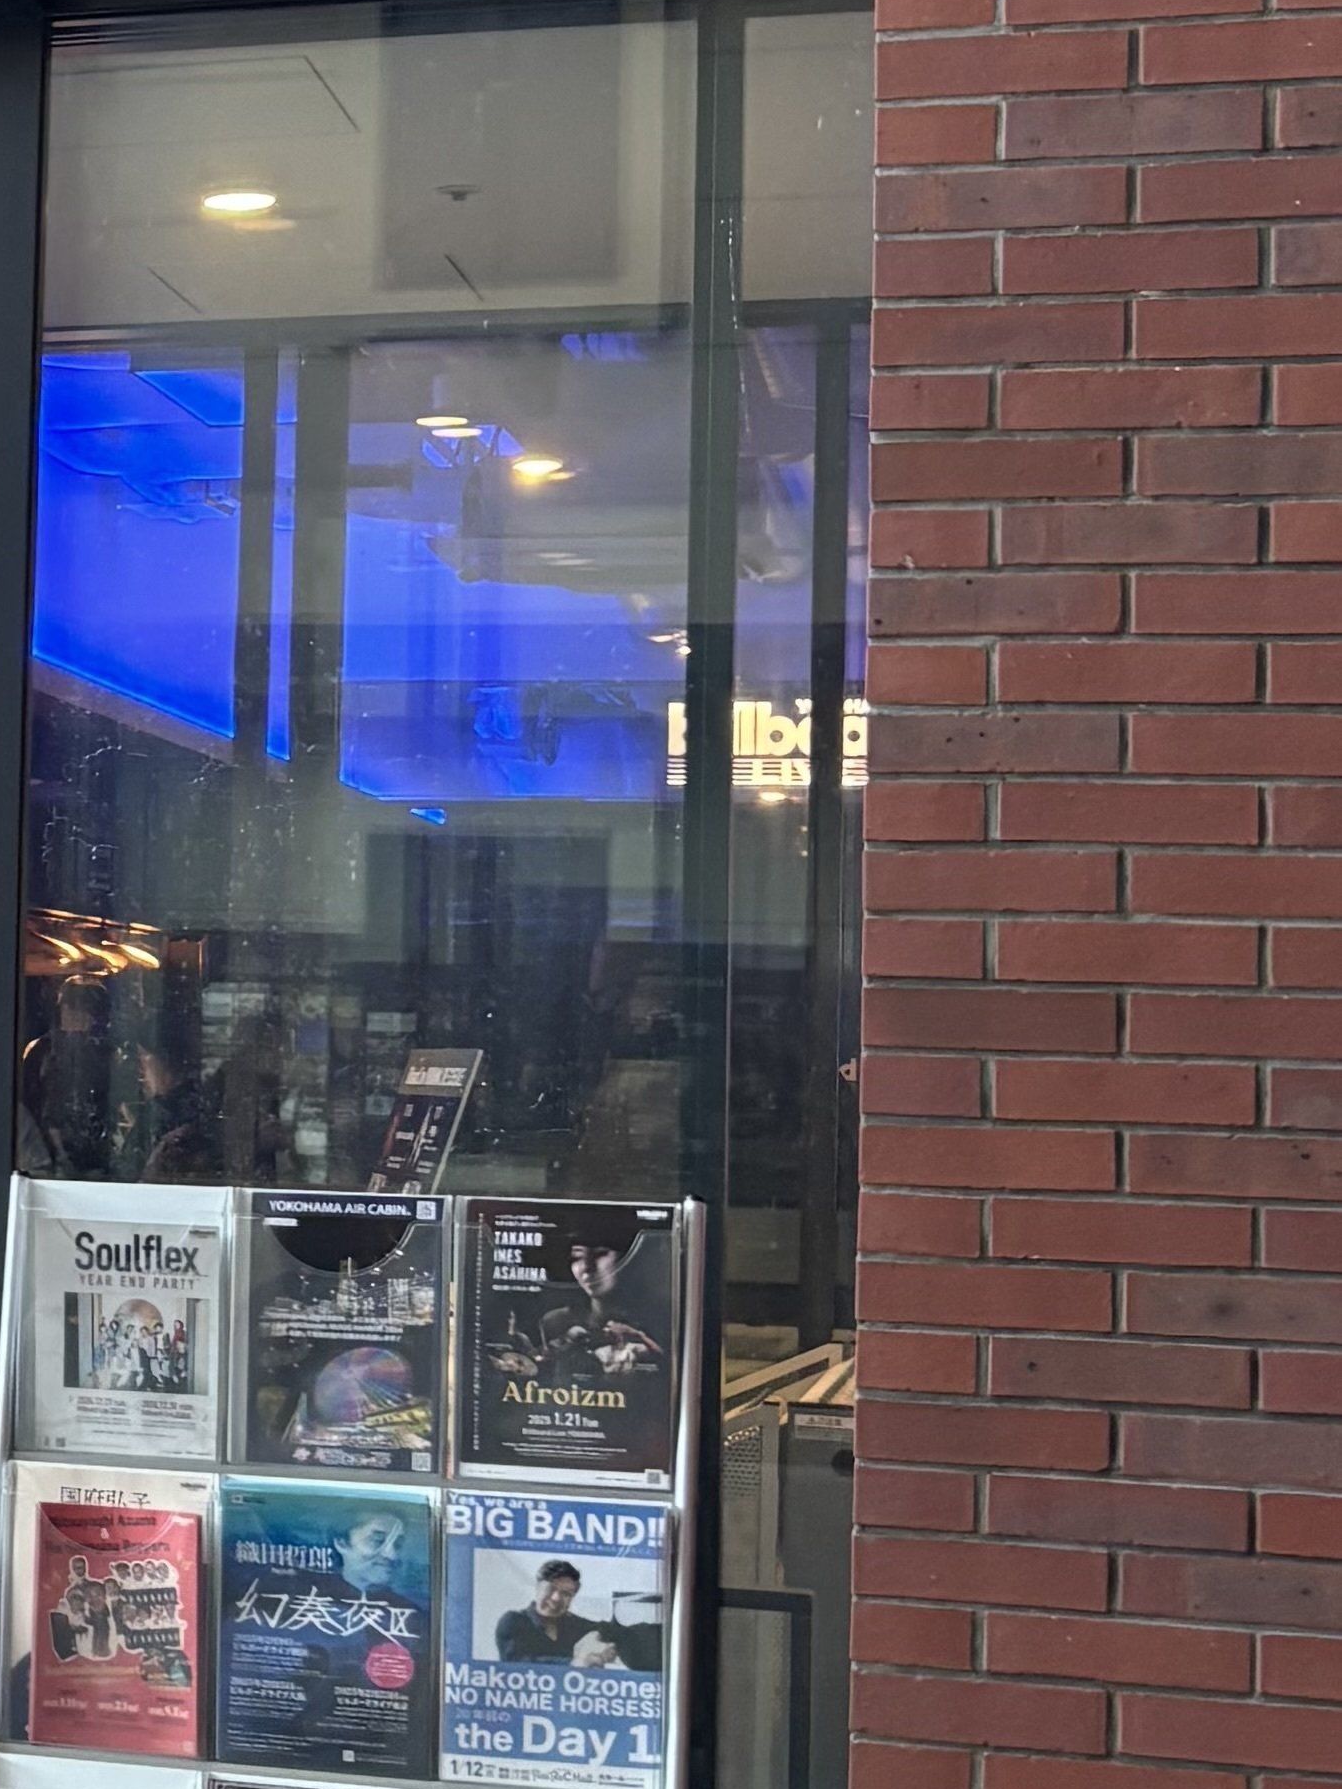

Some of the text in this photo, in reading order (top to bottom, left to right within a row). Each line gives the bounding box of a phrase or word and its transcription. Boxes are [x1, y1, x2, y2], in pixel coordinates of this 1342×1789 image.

[269, 1199, 342, 1214] YOKOHAMA
[344, 1201, 367, 1215] AIR
[74, 1230, 200, 1274] Soulflex
[78, 1273, 197, 1292] YEAR END PARTY
[501, 1379, 627, 1409] Afroizm
[482, 1496, 508, 1508] we
[508, 1497, 535, 1509] are
[445, 1504, 514, 1538] BIG
[445, 1662, 556, 1693] Makoto
[444, 1686, 661, 1719] NO NAME HORSES
[454, 1714, 661, 1767] the Day 1
